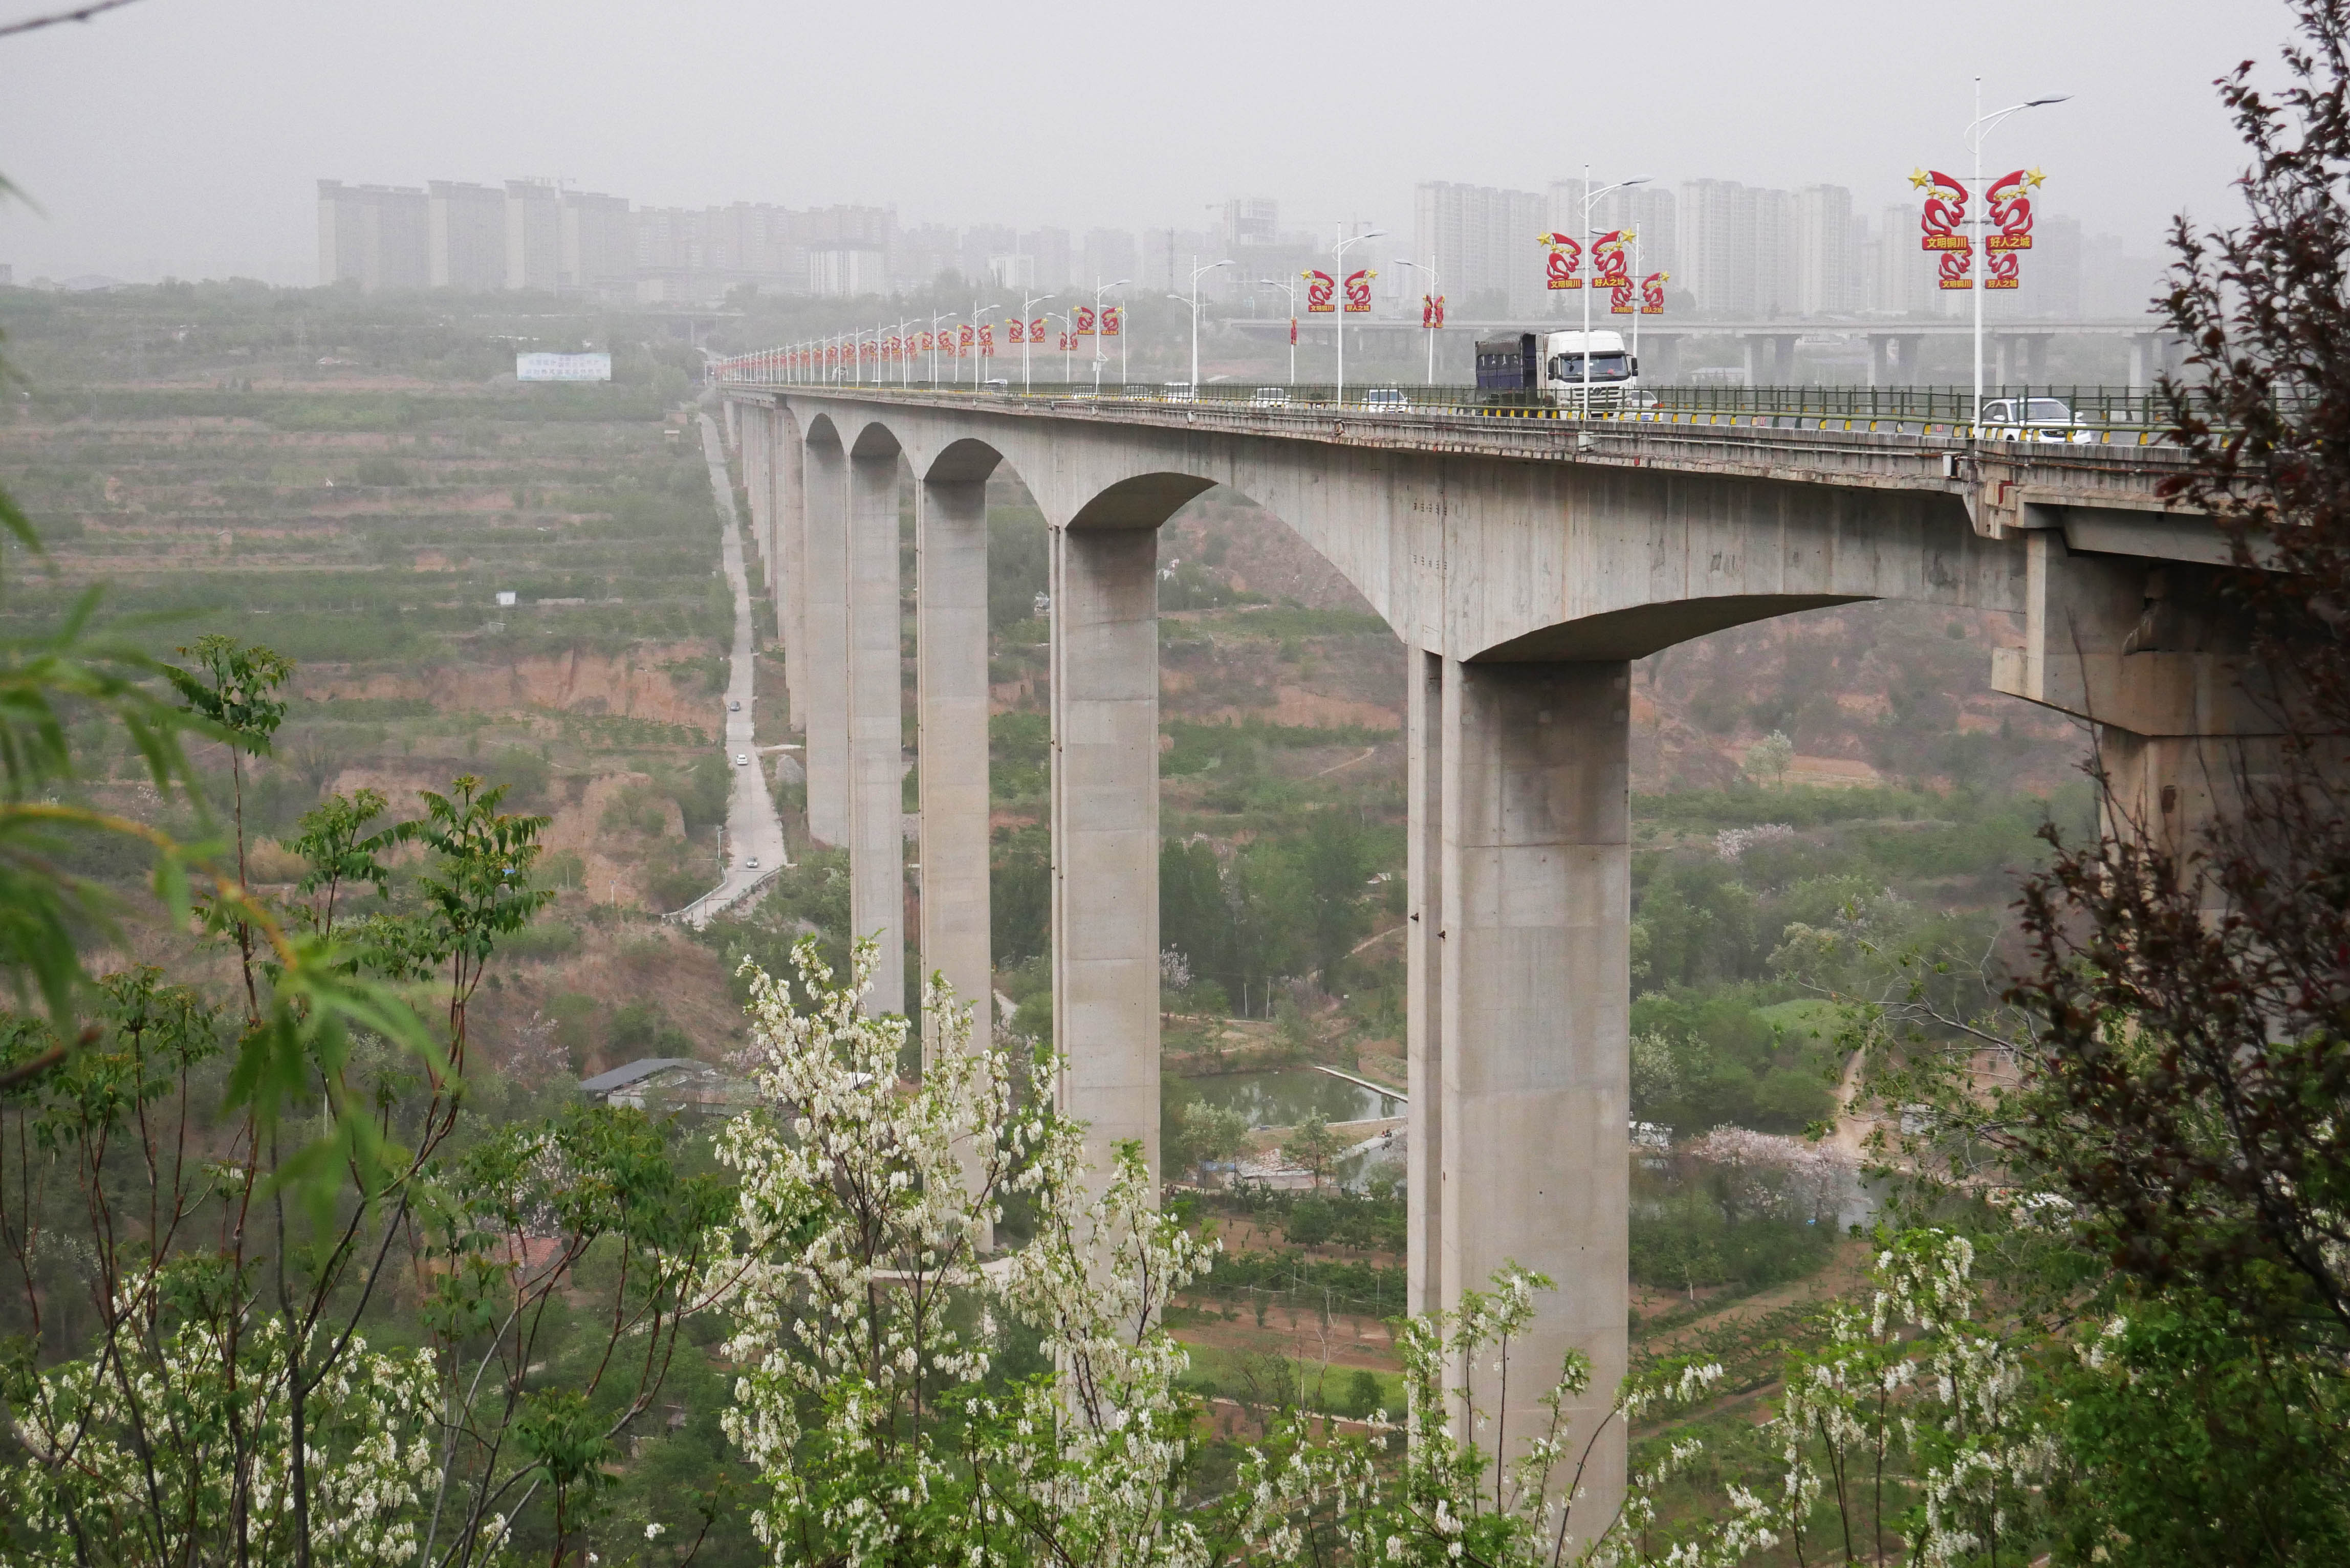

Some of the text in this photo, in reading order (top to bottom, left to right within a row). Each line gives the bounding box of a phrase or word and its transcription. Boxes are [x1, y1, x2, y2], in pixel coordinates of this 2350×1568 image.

[1927, 237, 1967, 248] 文明铜川
[1990, 236, 2031, 248] 好人之城
[1551, 279, 1580, 288] 文明铜川
[1595, 278, 1625, 287] 好人之城
